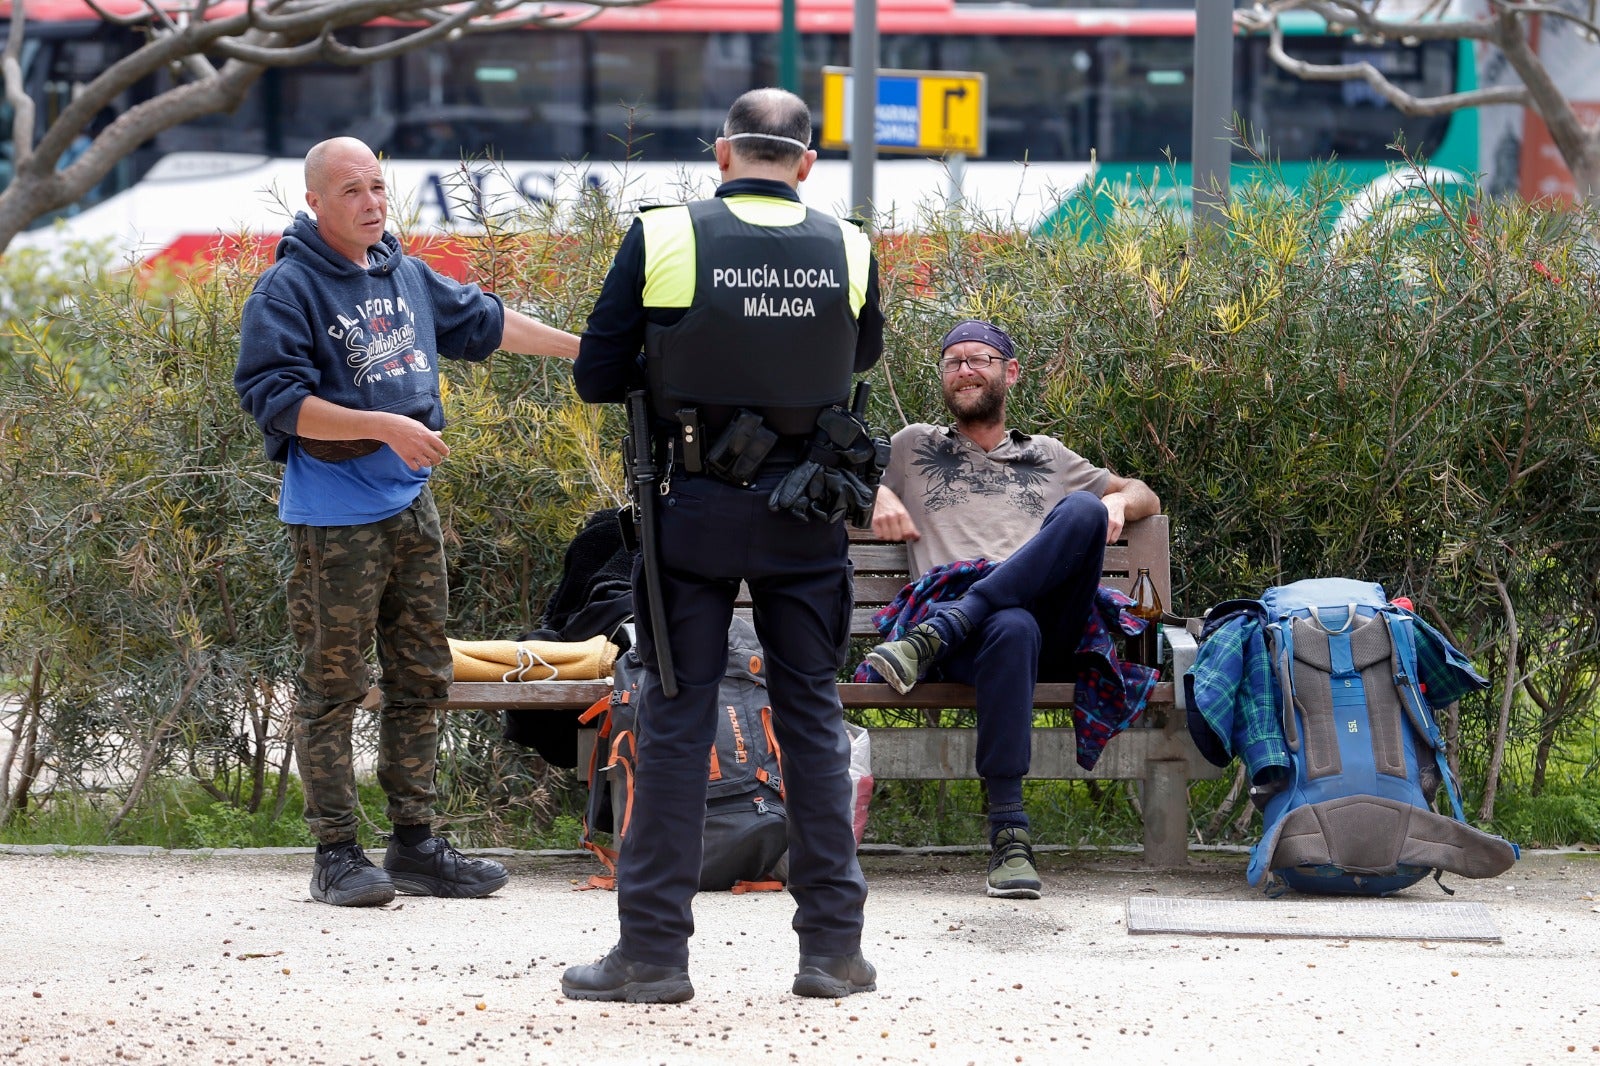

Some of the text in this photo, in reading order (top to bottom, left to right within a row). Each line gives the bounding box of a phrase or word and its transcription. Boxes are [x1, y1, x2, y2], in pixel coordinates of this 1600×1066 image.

[713, 264, 840, 288] POLICÍA LOCAL
[744, 293, 816, 317] MÁLAGA
[385, 367, 408, 378] YORK
[1344, 680, 1351, 688] S
[726, 705, 748, 764] mountain
